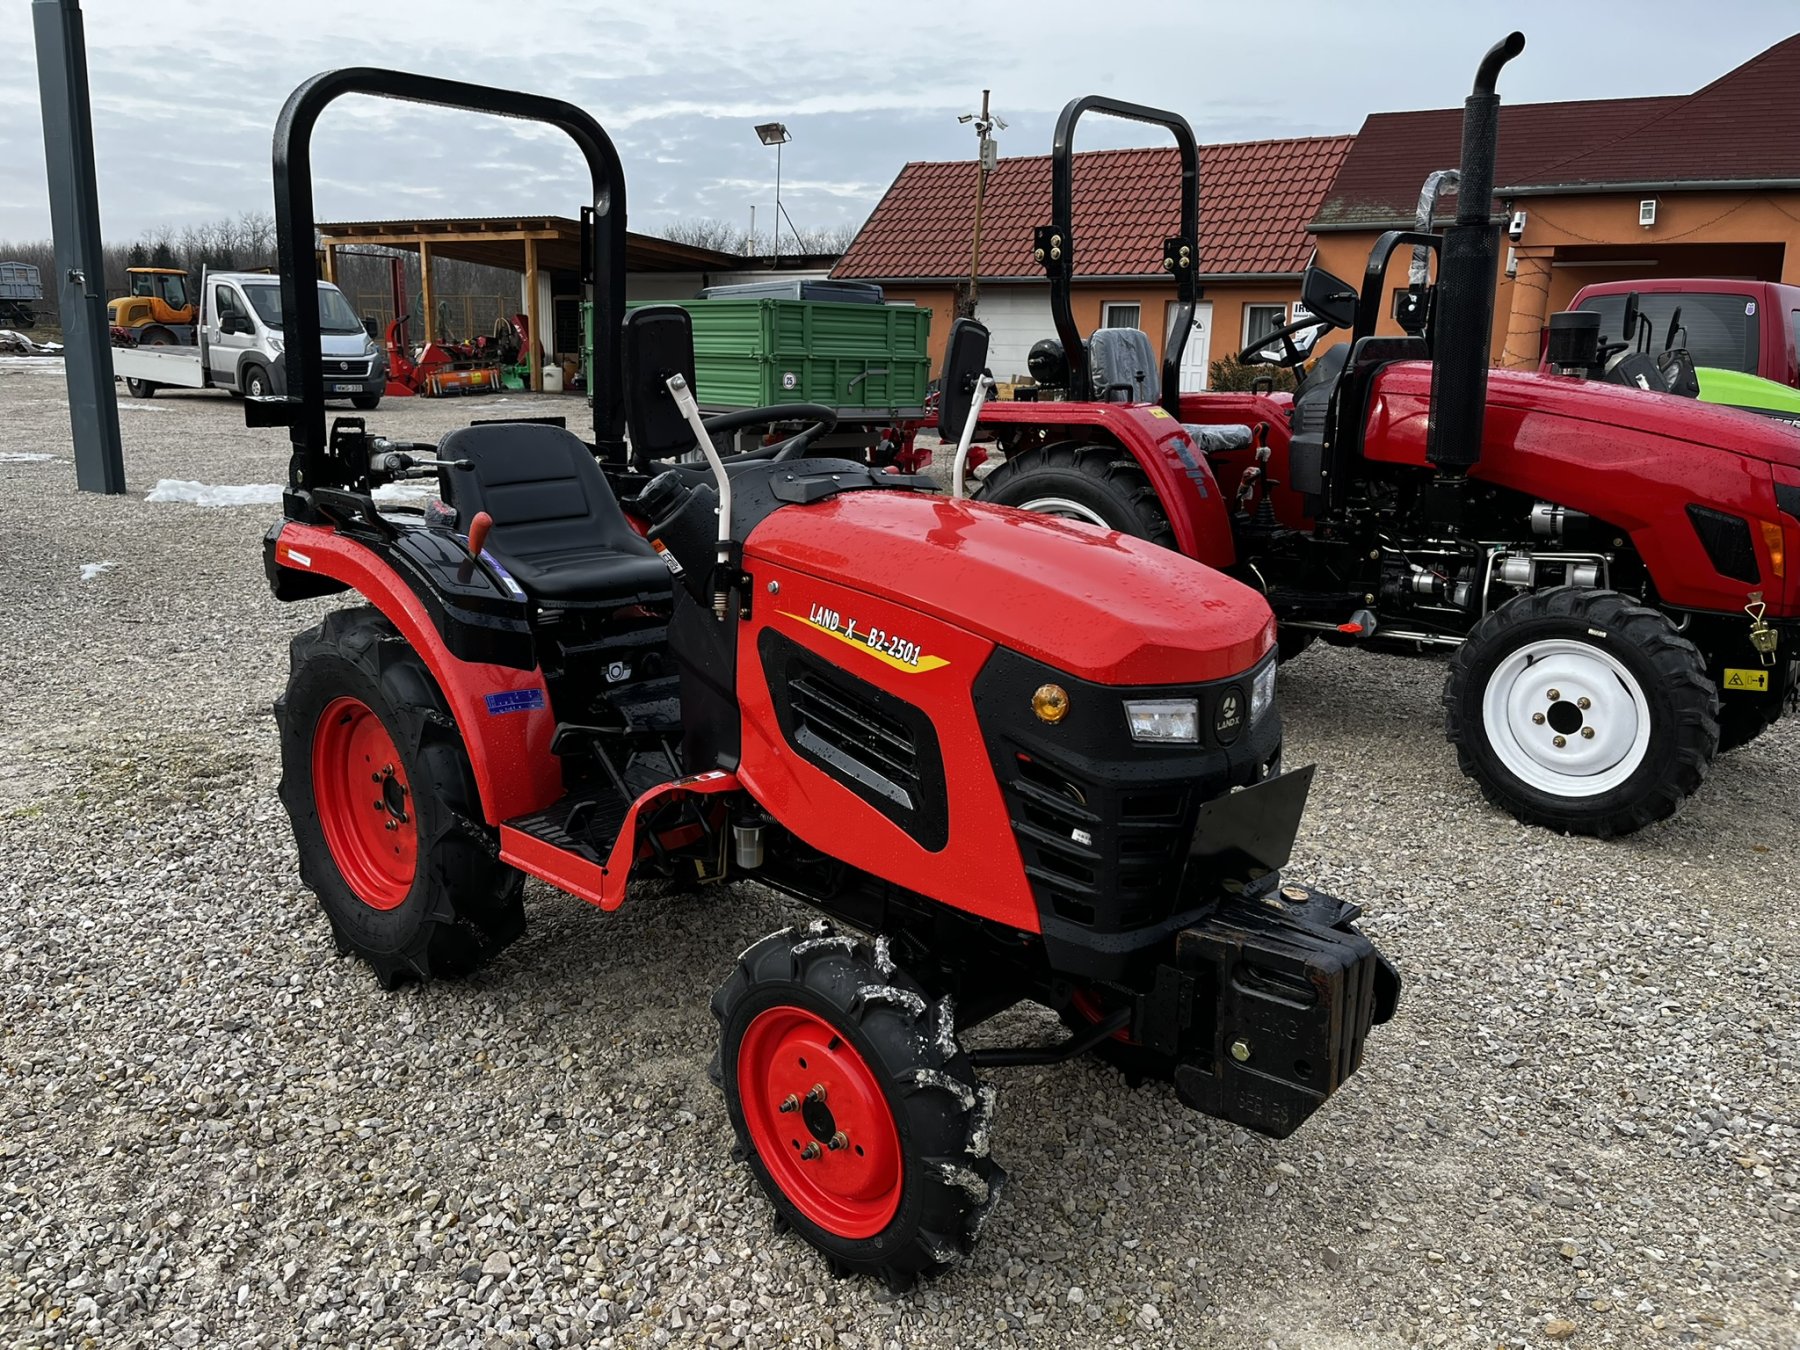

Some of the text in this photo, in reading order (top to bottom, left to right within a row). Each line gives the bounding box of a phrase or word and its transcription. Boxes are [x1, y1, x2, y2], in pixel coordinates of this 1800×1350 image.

[808, 602, 922, 667] LAND X B2-2501
